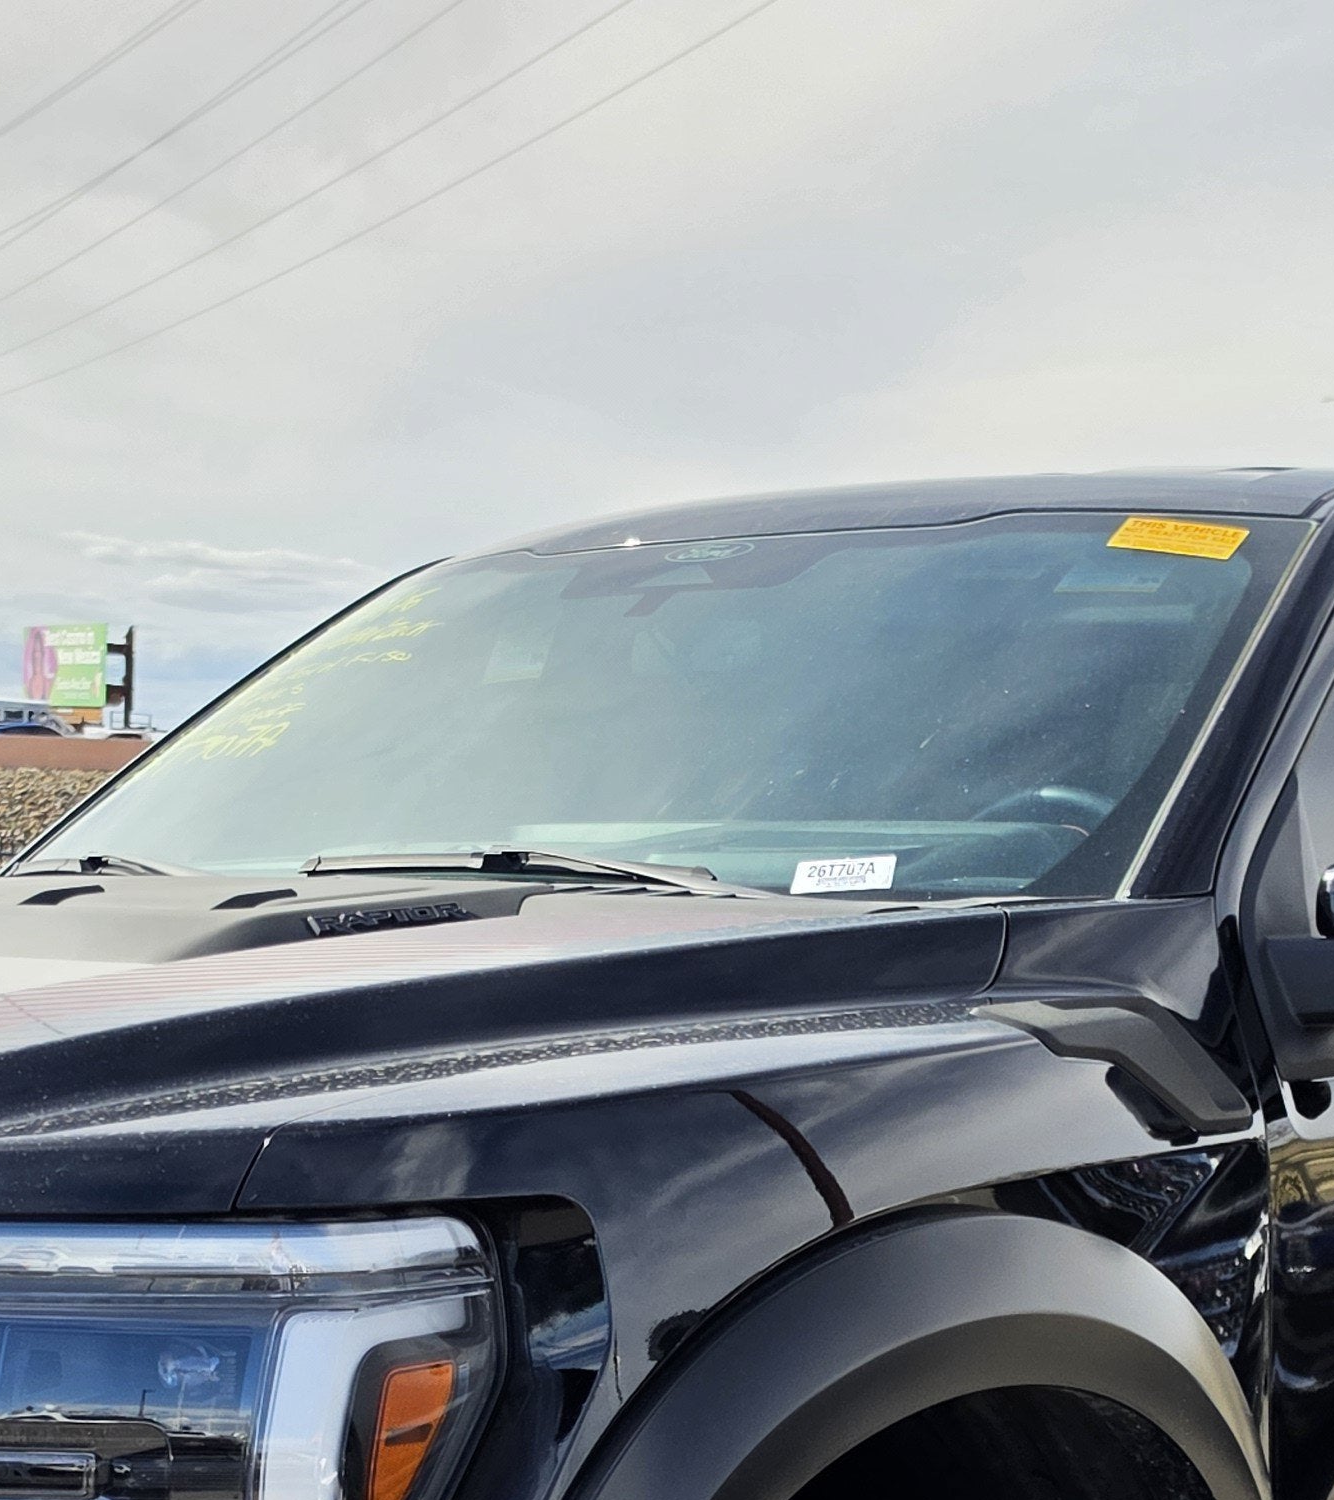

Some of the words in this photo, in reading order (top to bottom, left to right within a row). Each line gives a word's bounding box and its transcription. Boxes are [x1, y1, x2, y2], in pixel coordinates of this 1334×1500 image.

[1130, 519, 1168, 530] THIS
[1173, 523, 1241, 539] VEHICLE
[306, 902, 467, 937] RAPTOR
